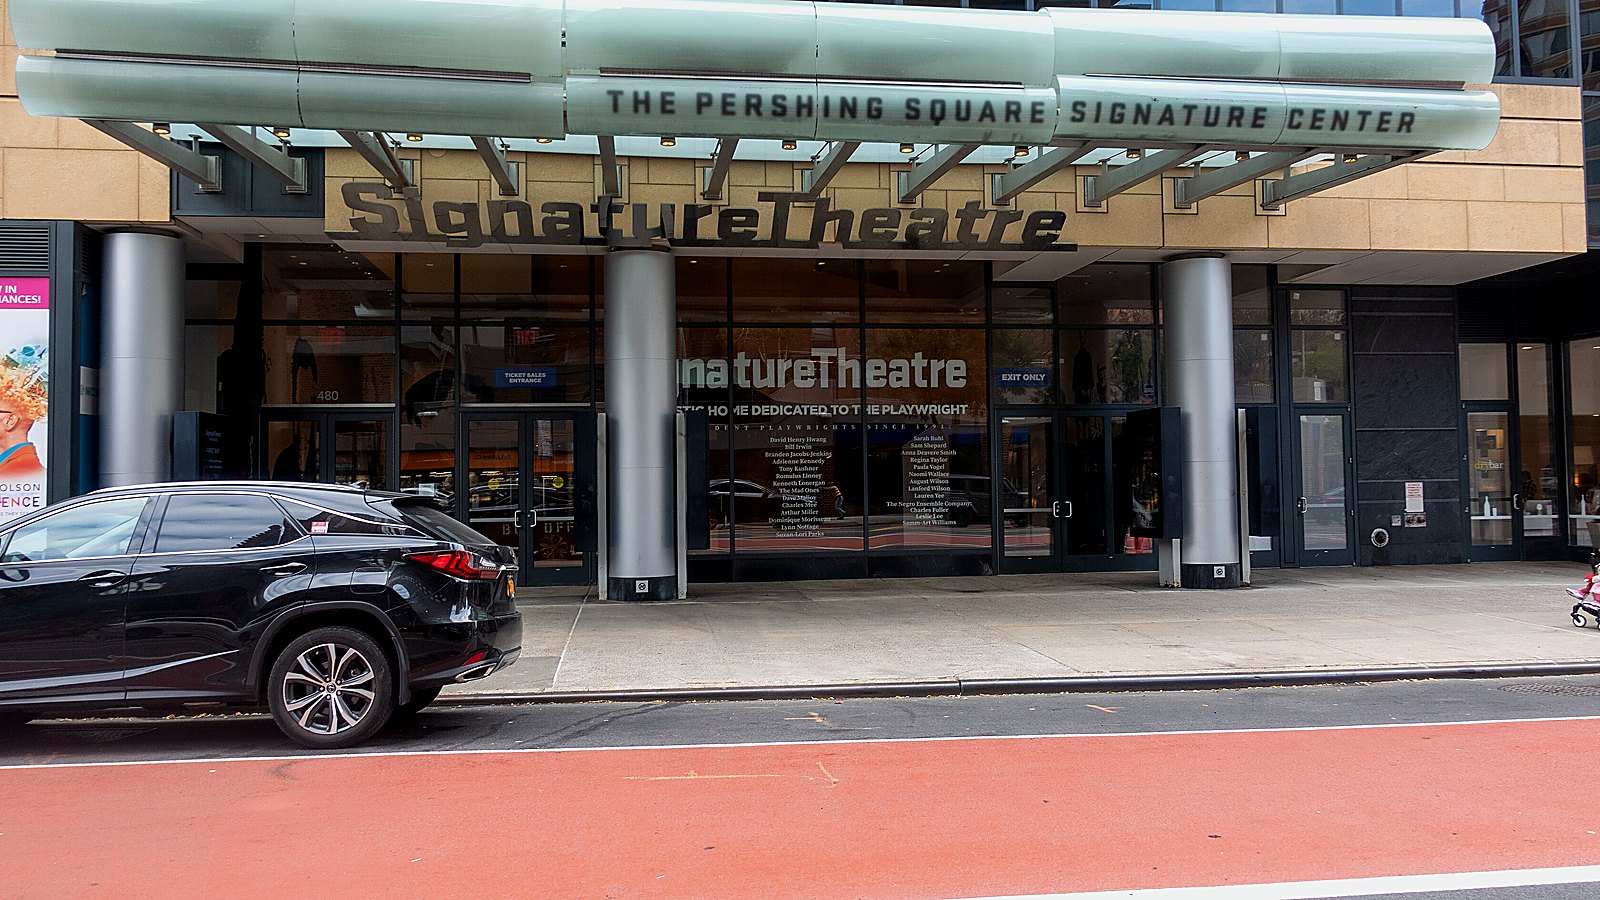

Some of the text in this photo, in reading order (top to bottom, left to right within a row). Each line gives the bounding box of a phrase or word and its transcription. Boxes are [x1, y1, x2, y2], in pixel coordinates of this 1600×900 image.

[606, 89, 1416, 134] THE PERSHING SQUARE SIGNATURE CENTER
[5, 285, 17, 294] IN
[0, 295, 41, 304] ANCES!
[677, 347, 967, 392] natureTheatre
[317, 390, 339, 401] 480
[708, 405, 749, 416] HOME
[752, 405, 828, 416] DEDICATED
[831, 405, 849, 415] TO
[882, 404, 968, 415] PLAYWRIGHT
[0, 483, 41, 492] OLSON
[0, 496, 40, 508] ENCE
